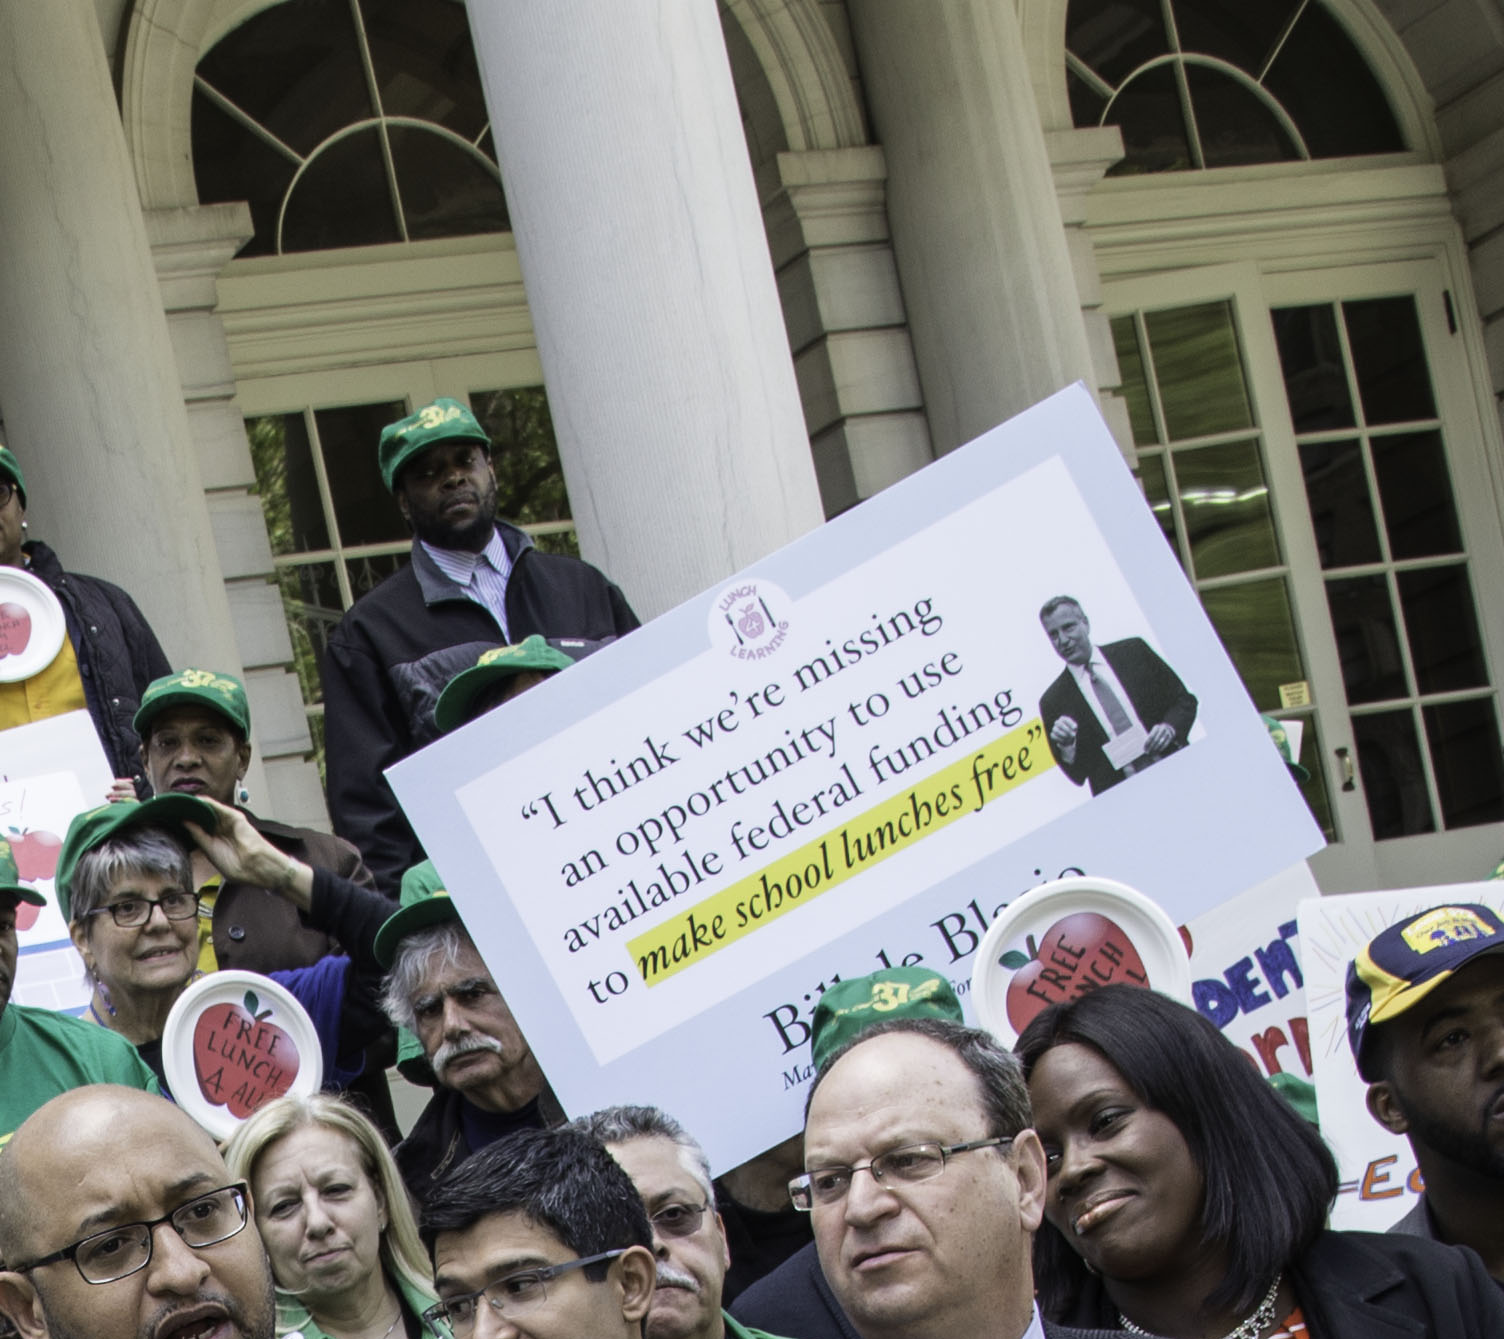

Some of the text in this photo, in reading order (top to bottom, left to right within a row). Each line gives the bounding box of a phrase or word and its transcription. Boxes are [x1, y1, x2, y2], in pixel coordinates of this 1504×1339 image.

[719, 584, 757, 611] LUNCH
[730, 620, 789, 661] LEARNING
[573, 738, 682, 811] think
[793, 597, 944, 692] missing
[560, 650, 965, 888] an opportunity to use
[563, 688, 1025, 955] available federal funding
[587, 969, 630, 1005] to
[637, 913, 728, 982] make
[735, 853, 836, 928] school
[840, 776, 965, 872] lunches
[1026, 933, 1087, 1005] FREE
[1071, 941, 1124, 998] NCH
[207, 1030, 283, 1089] LUNCH
[222, 1009, 282, 1058] FREE
